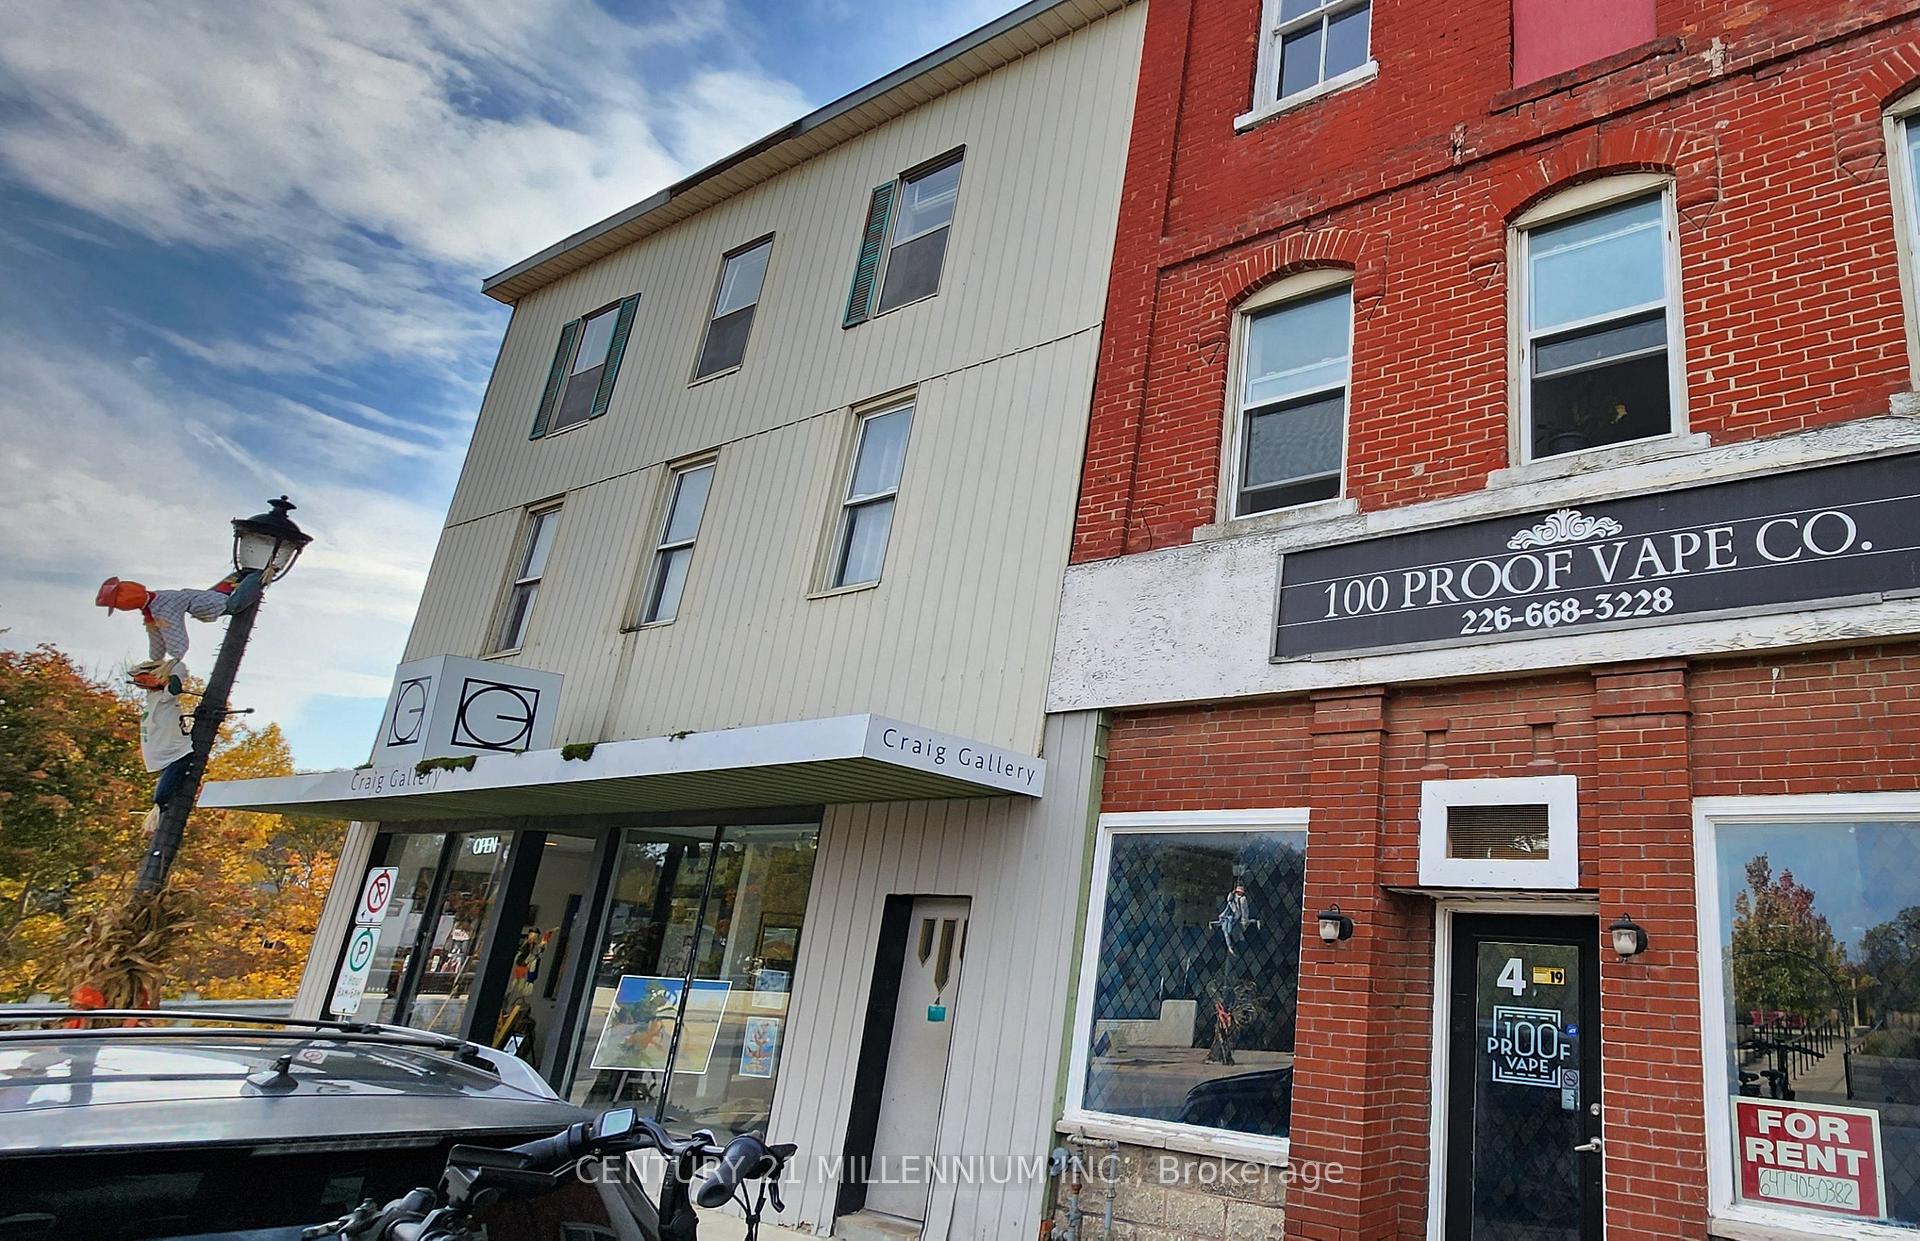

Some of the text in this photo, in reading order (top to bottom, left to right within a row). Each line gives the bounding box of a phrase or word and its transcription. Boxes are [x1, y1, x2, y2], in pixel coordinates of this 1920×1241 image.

[1323, 510, 1873, 619] 100 PROOF VAPE CO.
[1460, 586, 1674, 635] 226-668-3228
[882, 728, 1035, 786] Craig Gallery
[351, 766, 441, 794] Craig Gallery
[472, 836, 499, 855] OPEN
[1496, 957, 1527, 996] 4
[1550, 970, 1564, 984] 19
[1505, 1055, 1549, 1073] VAPE
[1757, 1108, 1850, 1144] FOR
[1745, 1136, 1868, 1176] RENT
